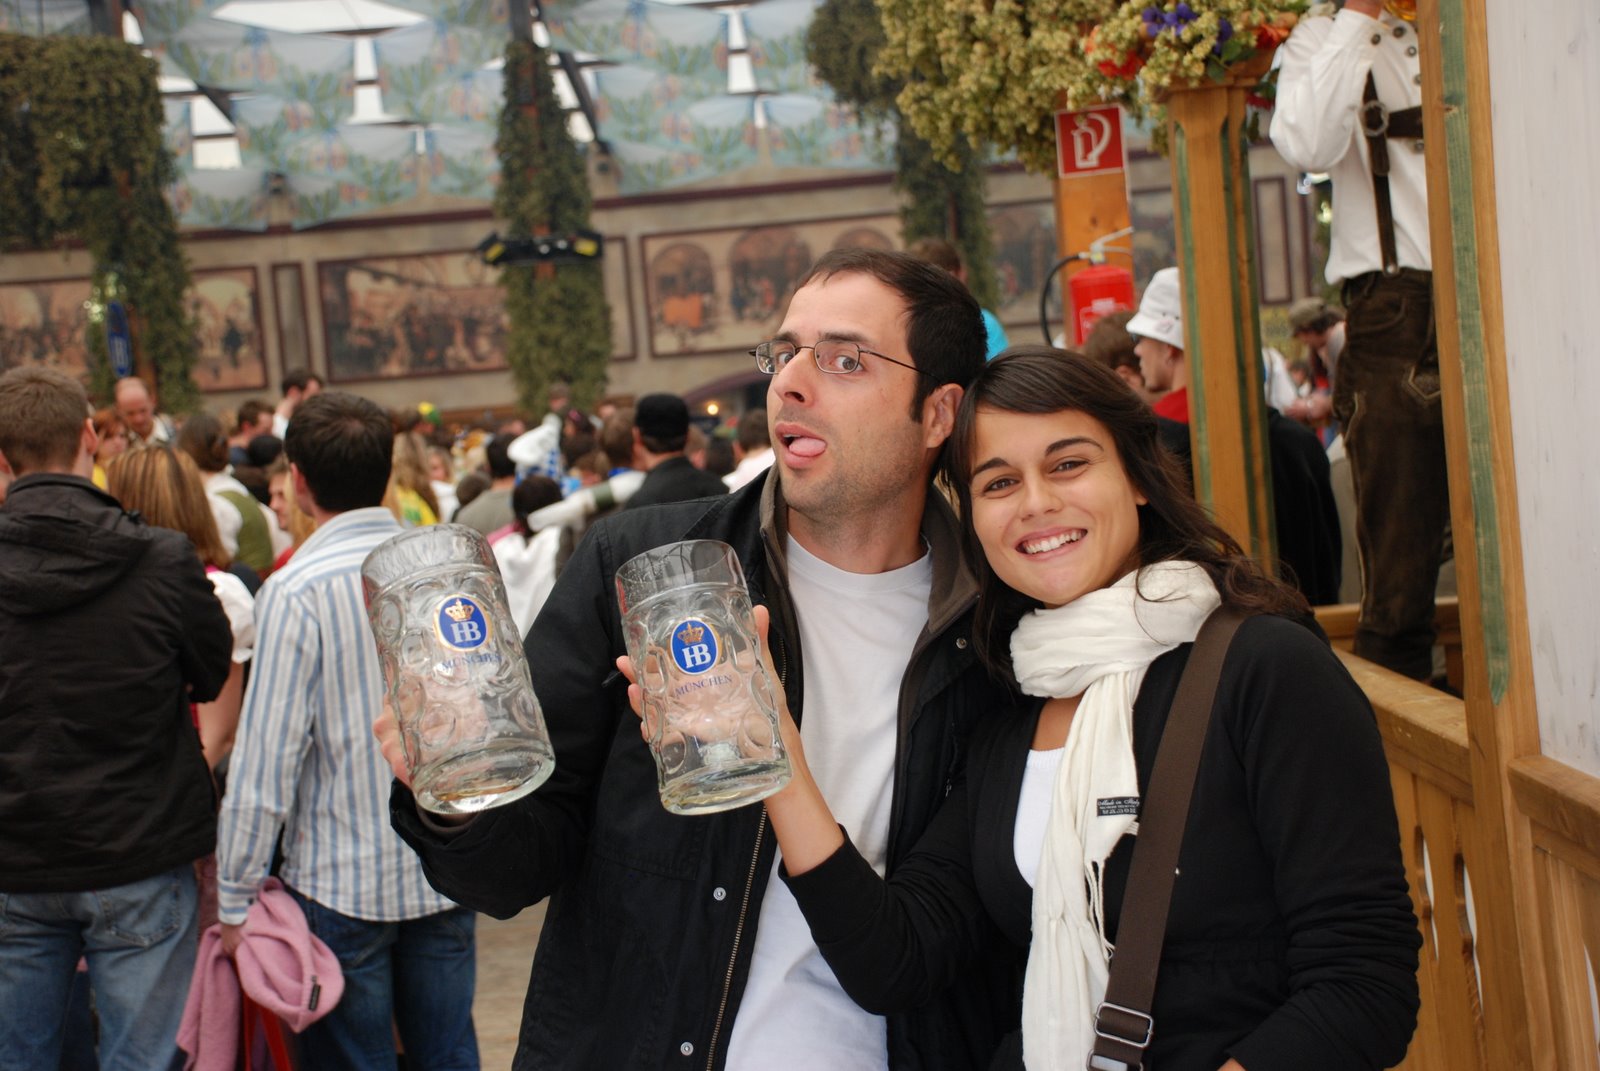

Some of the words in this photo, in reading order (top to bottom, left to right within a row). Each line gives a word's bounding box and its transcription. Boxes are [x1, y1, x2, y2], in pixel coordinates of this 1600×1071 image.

[450, 620, 482, 644] HB
[682, 643, 712, 669] HB
[674, 674, 733, 697] MÜNCHEN
